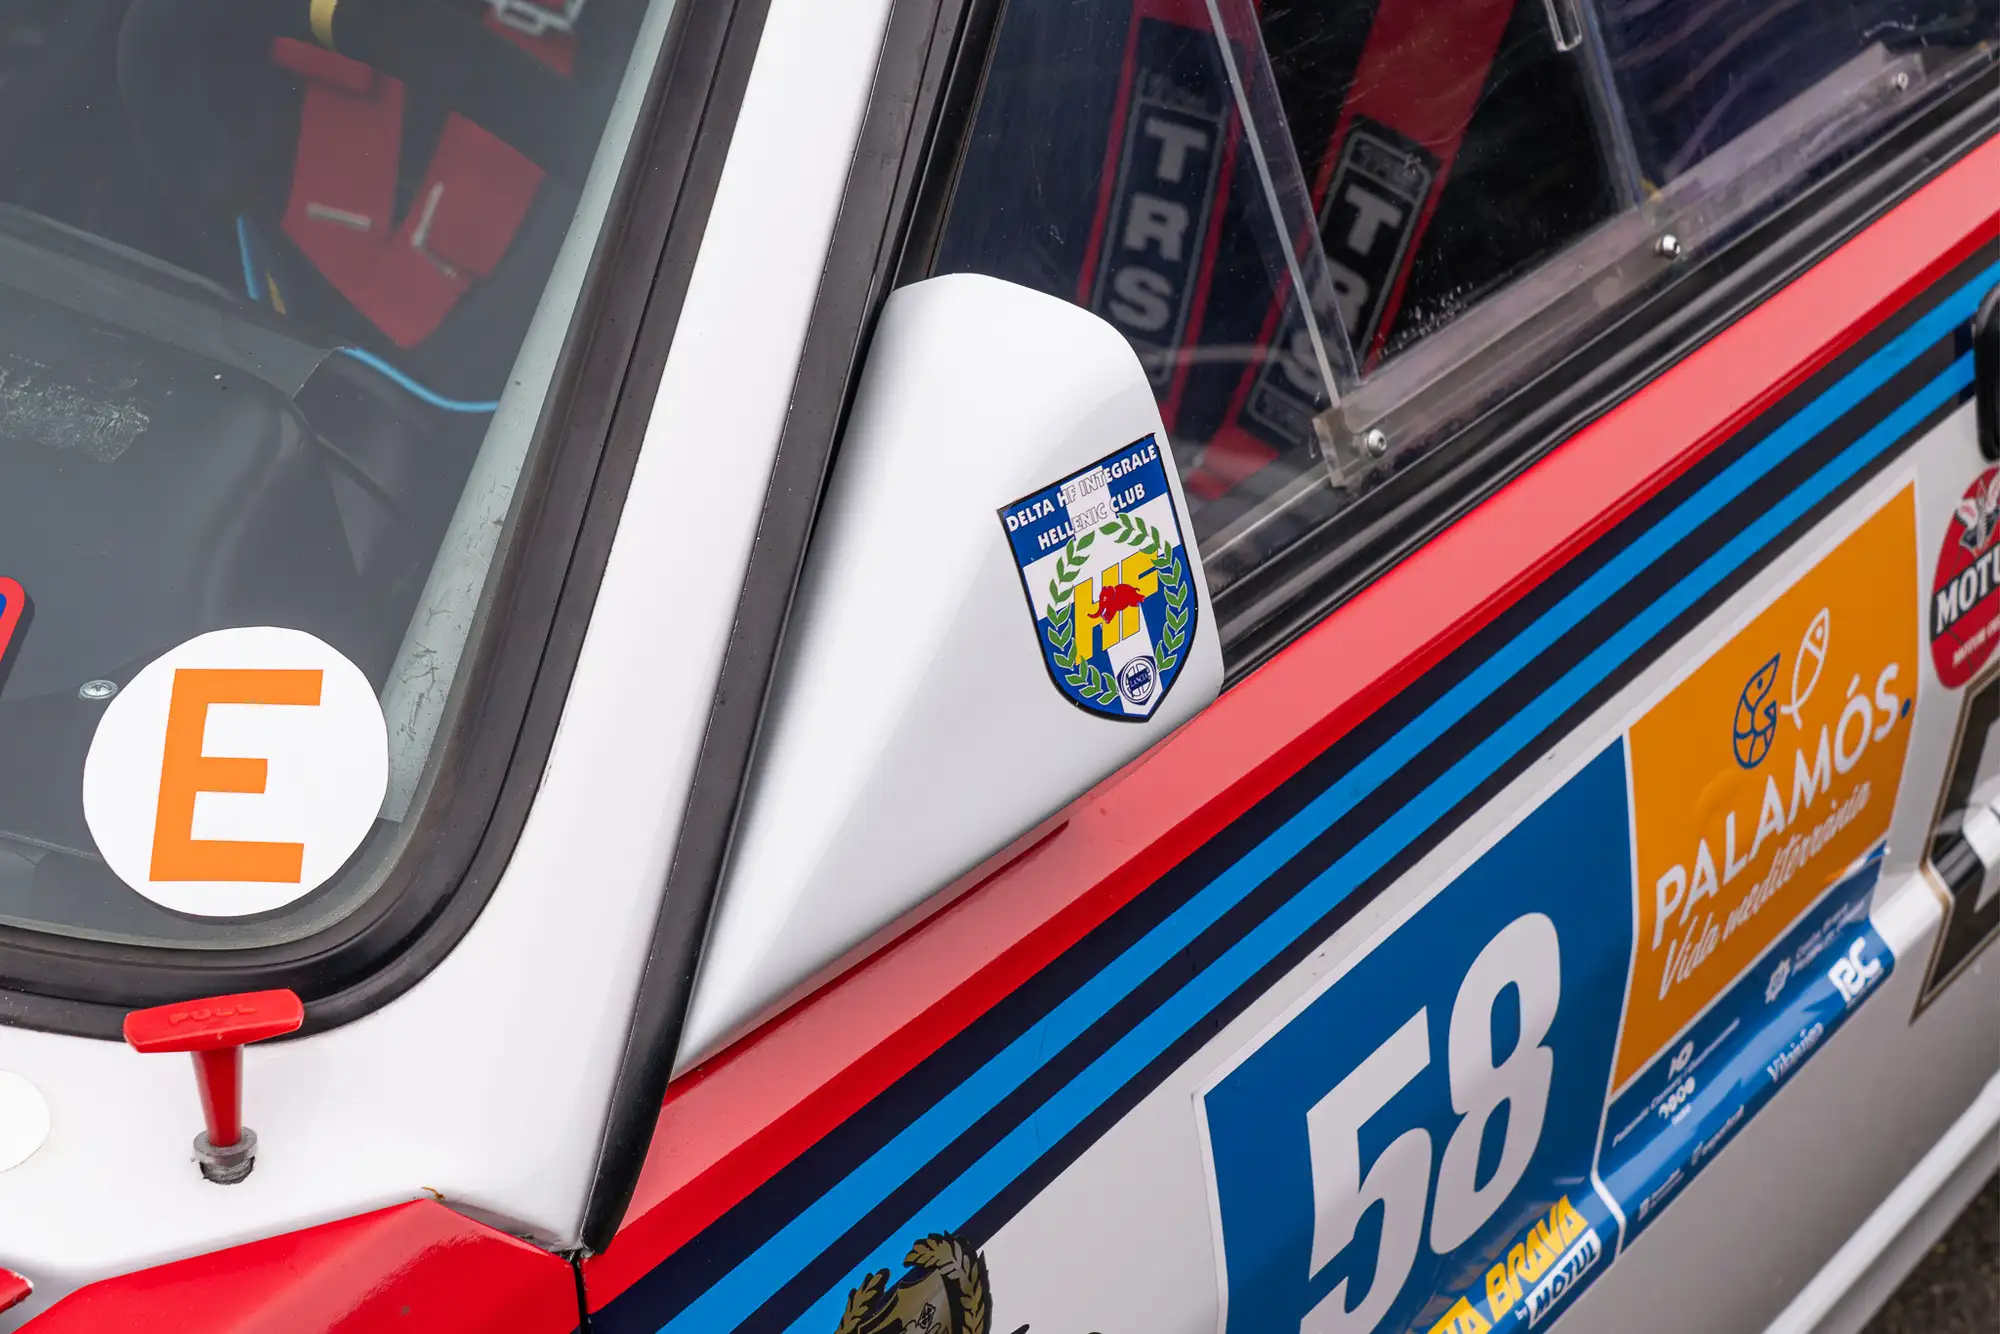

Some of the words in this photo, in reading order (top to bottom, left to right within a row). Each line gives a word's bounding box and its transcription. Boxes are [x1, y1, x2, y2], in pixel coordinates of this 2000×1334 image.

[1110, 117, 1208, 333] TRS
[1005, 498, 1056, 532] DELTA
[1056, 485, 1077, 508] HF
[1078, 444, 1158, 497] INTEGRALE
[1037, 503, 1108, 551] HELLENIC
[1108, 482, 1146, 514] CLUB
[1074, 548, 1159, 666] HF
[149, 668, 323, 883] E
[1658, 911, 1720, 1001] Vida
[168, 1003, 259, 1026] PULL
[1300, 912, 1561, 1334] 58
[1485, 1194, 1589, 1323] BRAVA
[1532, 1240, 1599, 1321] MOTUL
